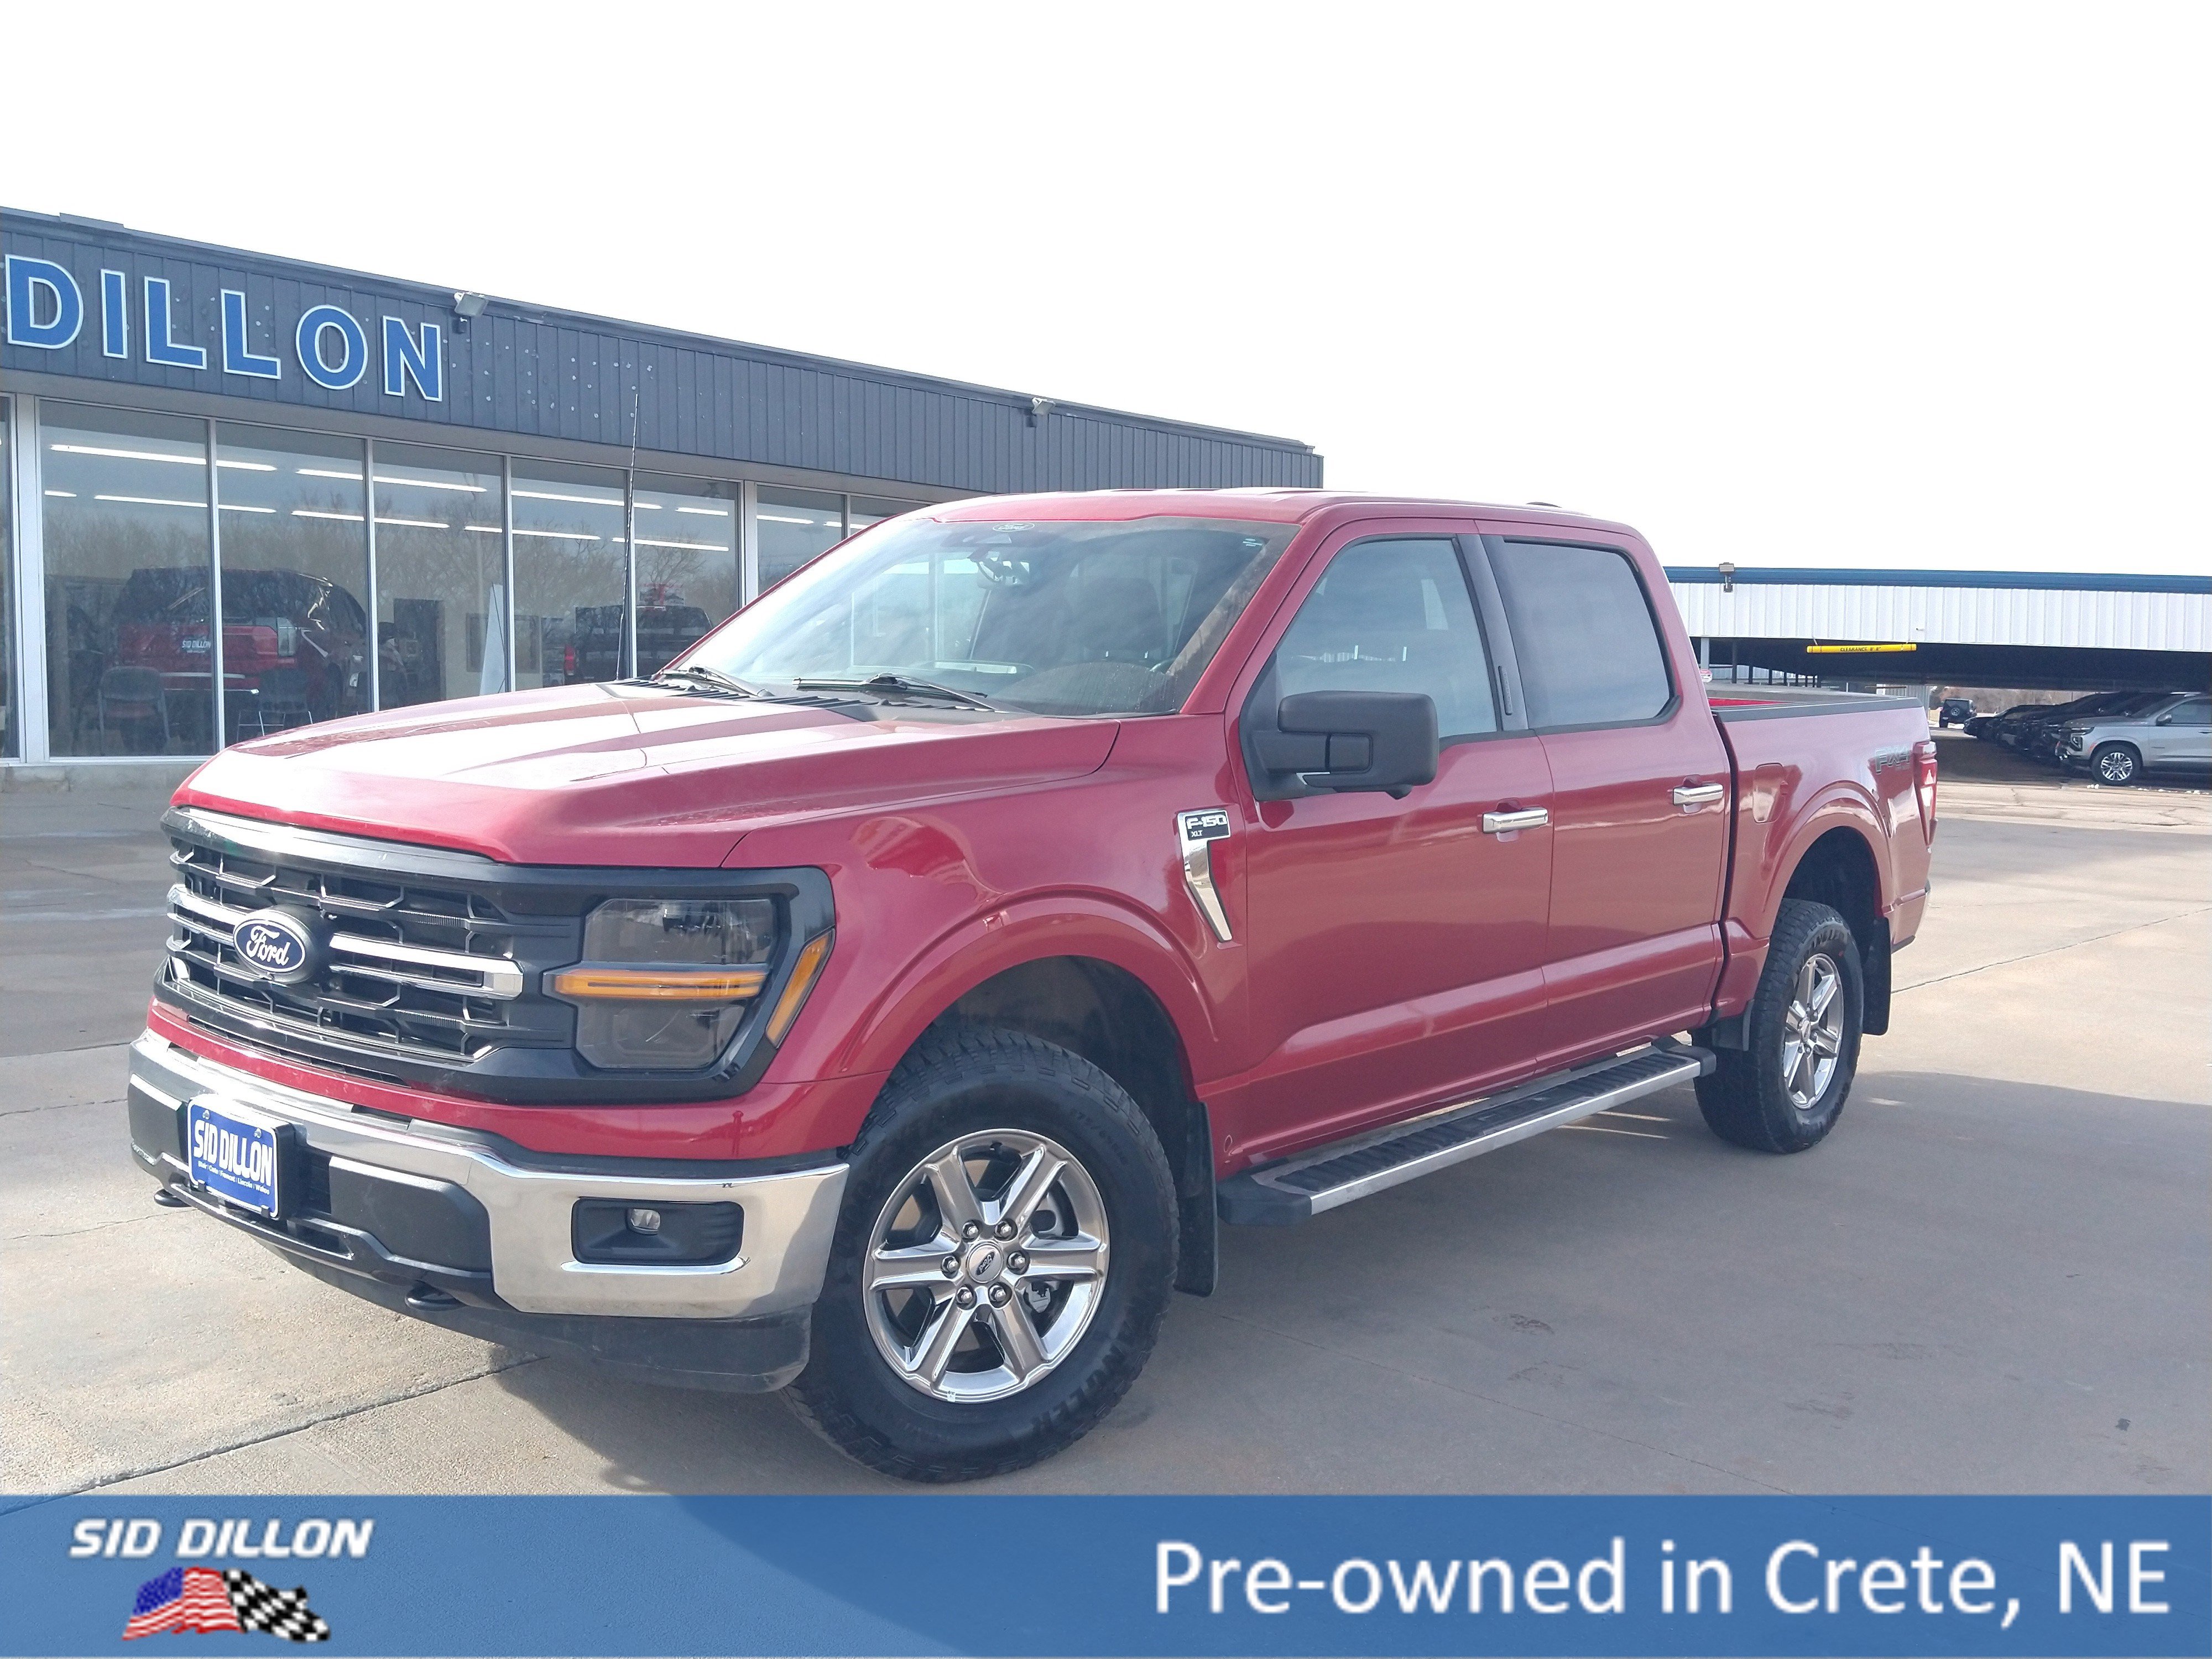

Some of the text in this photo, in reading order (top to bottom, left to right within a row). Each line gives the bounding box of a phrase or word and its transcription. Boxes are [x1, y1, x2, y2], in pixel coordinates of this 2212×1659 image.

[5, 254, 442, 401] DILLON
[1876, 746, 1910, 774] FX4
[1186, 814, 1228, 830] F-150
[246, 925, 291, 966] Ford
[194, 1119, 273, 1187] SID DILLON
[978, 1254, 993, 1273] Ford
